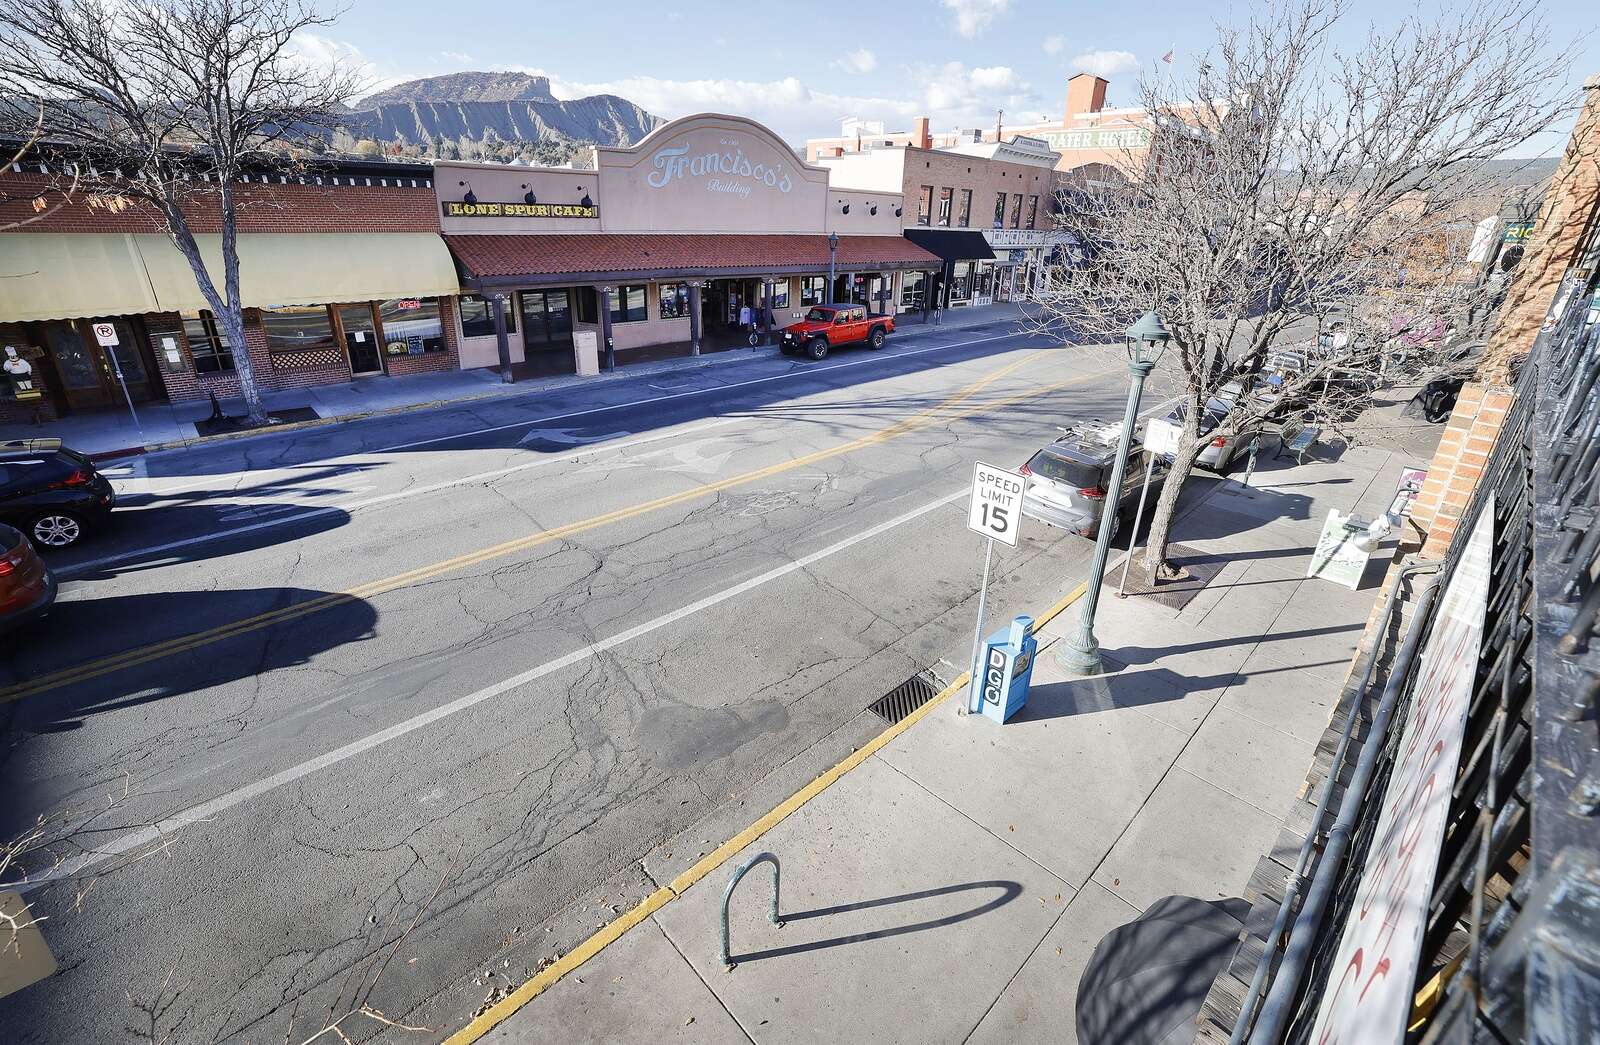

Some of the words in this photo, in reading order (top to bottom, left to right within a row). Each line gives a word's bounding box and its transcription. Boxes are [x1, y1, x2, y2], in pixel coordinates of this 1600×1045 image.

[1098, 128, 1146, 148] HOTEL
[648, 142, 793, 193] Francisco's
[707, 178, 751, 199] Building
[451, 203, 499, 216] LONE
[504, 204, 550, 217] SPUR
[554, 205, 592, 217] CAFE
[399, 300, 420, 309] OPEN
[978, 471, 1021, 494] SPEED
[981, 487, 1014, 507] LIMIT
[981, 503, 1009, 533] 15
